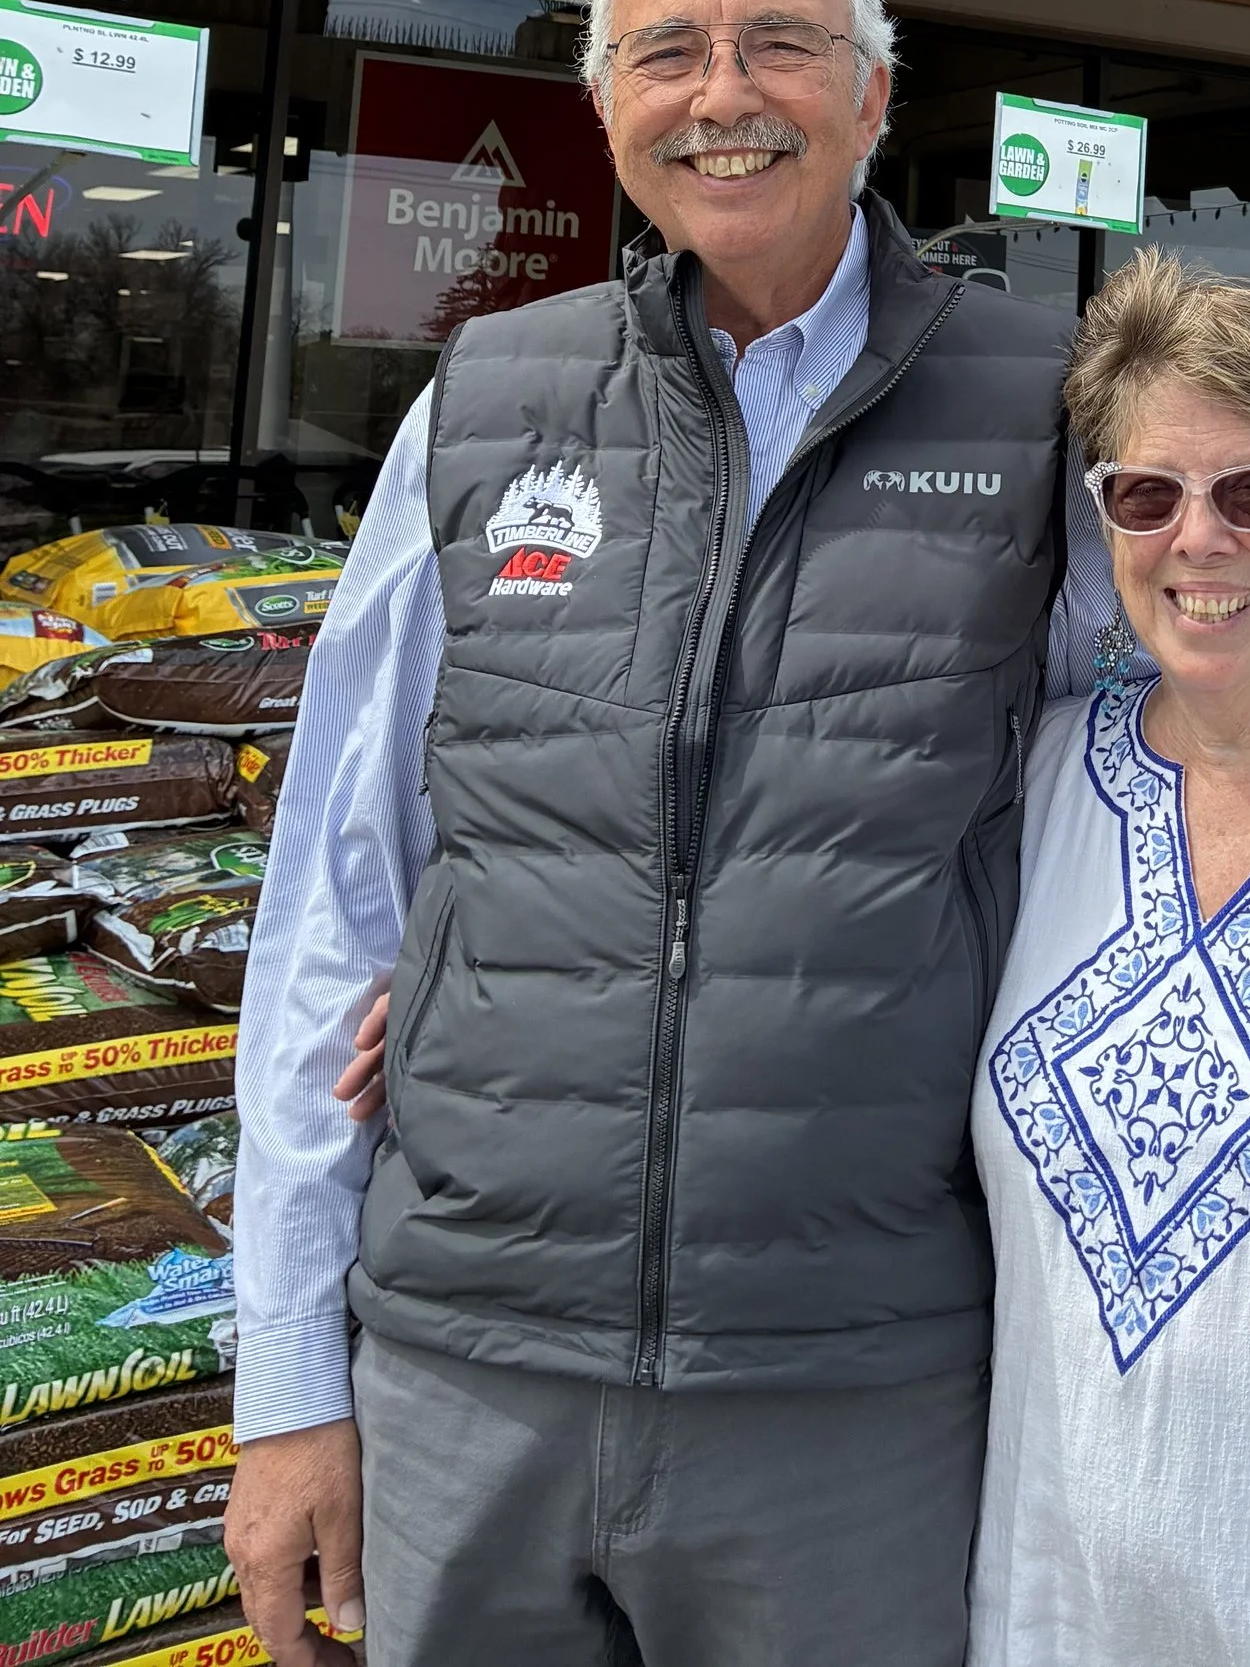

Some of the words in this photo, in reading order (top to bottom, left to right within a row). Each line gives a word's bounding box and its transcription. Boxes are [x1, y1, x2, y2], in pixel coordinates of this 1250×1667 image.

[22, 63, 35, 79] &
[92, 52, 136, 69] 12.99
[1000, 145, 1035, 165] LAWN
[1037, 153, 1046, 165] &
[1077, 141, 1106, 156] 26.99
[1000, 160, 1045, 182] GARDEN
[387, 189, 579, 240] Benjamin
[952, 254, 977, 266] HERE
[909, 471, 1002, 496] KUIU
[493, 524, 595, 552] TIMBERLINE
[498, 546, 572, 580] ACE
[488, 577, 574, 596] Hardware
[54, 742, 142, 767] Thicker
[9, 800, 76, 821] GRASS
[76, 795, 141, 816] PLUGS
[83, 1041, 141, 1070] 50%
[95, 1103, 167, 1123] GRASS
[168, 1094, 236, 1116] PLUGS
[148, 1258, 212, 1282] Water
[151, 1443, 169, 1458] UP
[175, 1432, 241, 1466] 50%
[54, 1457, 141, 1497] Grass
[147, 1459, 165, 1472] TO
[34, 1511, 106, 1545] SEED,
[112, 1495, 163, 1524] SOD
[165, 1487, 188, 1510] &
